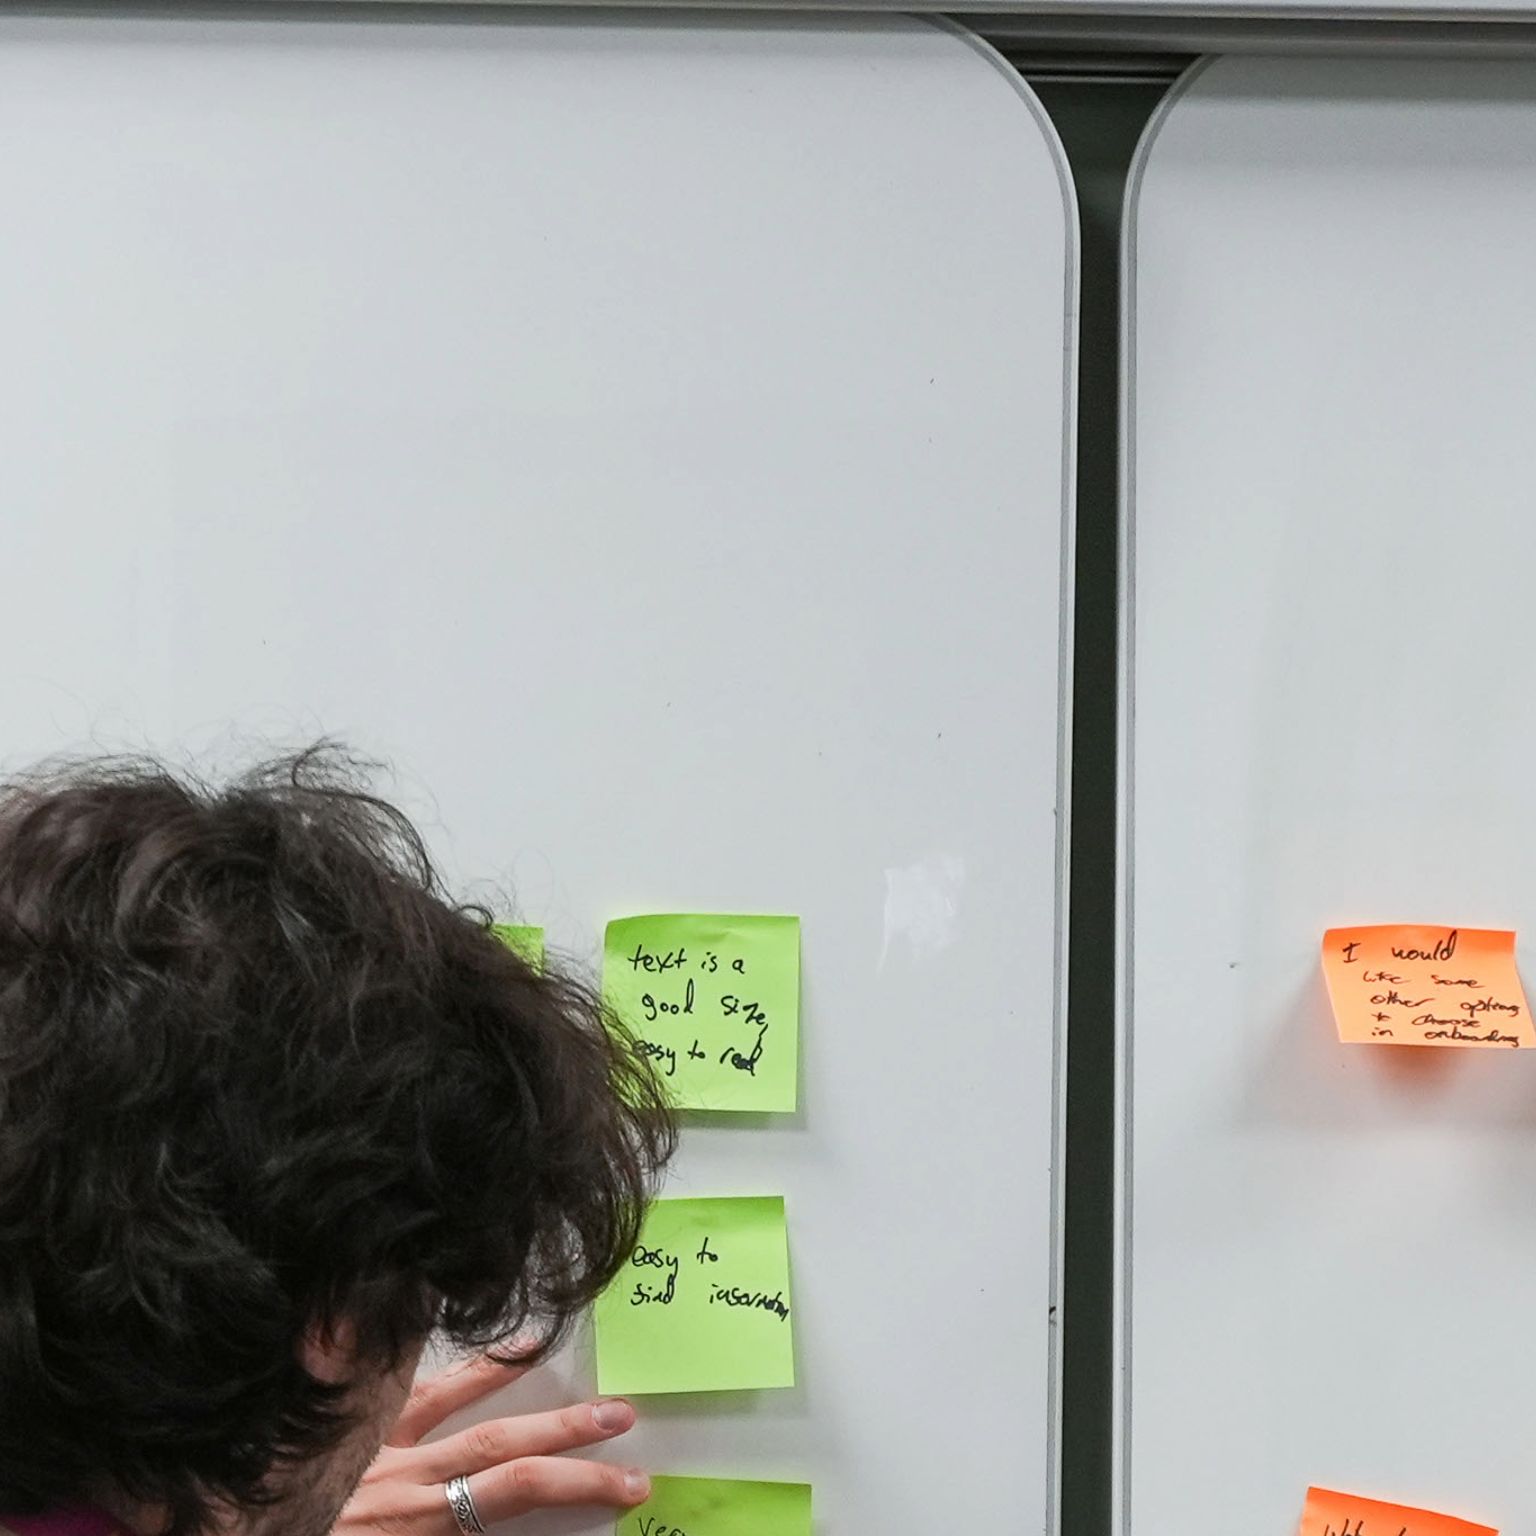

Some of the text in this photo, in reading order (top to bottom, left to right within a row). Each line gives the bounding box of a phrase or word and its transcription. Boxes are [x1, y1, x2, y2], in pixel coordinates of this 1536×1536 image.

[628, 945, 745, 973] text is a
[1343, 930, 1457, 963] I would
[642, 978, 694, 1020] good
[1370, 990, 1435, 1008] other
[1372, 1027, 1393, 1036] in
[688, 1040, 705, 1060] to
[697, 1237, 718, 1264] to
